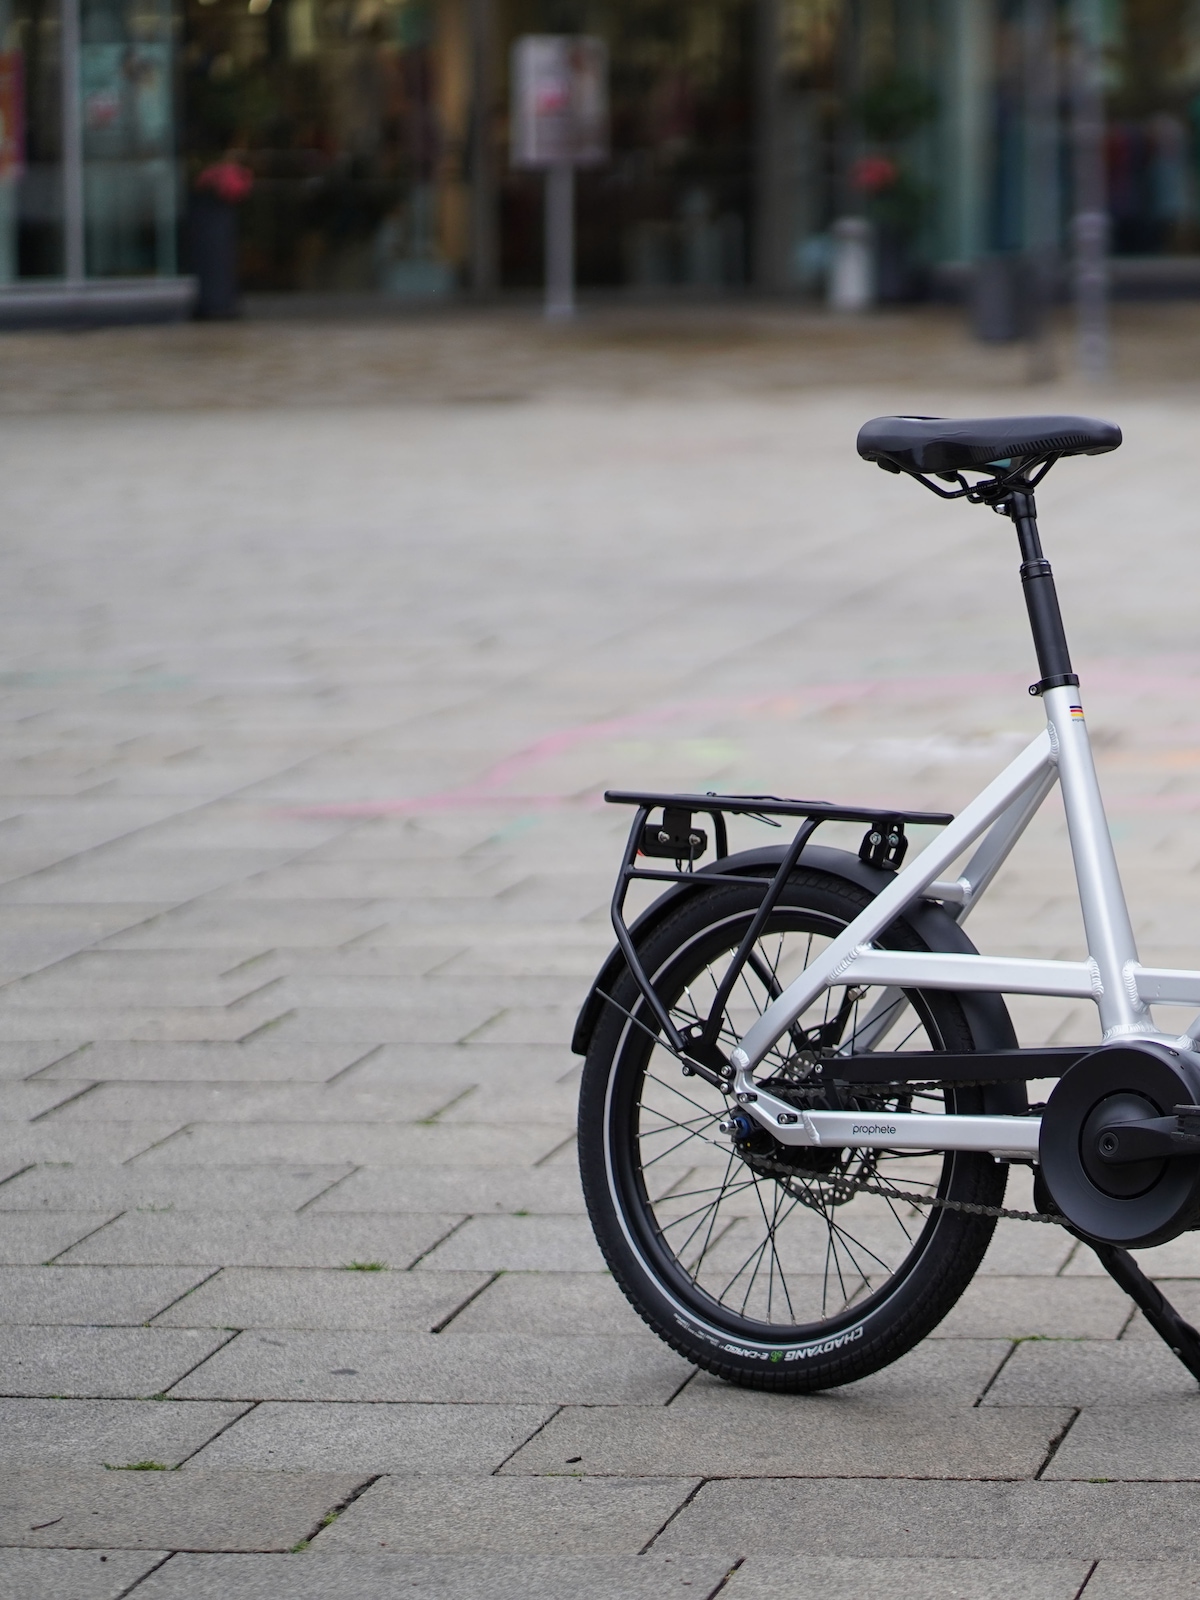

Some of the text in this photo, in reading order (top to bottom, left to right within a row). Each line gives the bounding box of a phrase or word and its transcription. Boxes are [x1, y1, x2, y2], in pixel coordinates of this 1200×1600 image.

[853, 1124, 896, 1135] prophete
[724, 1326, 864, 1361] CHAOYANG E-CARGO
